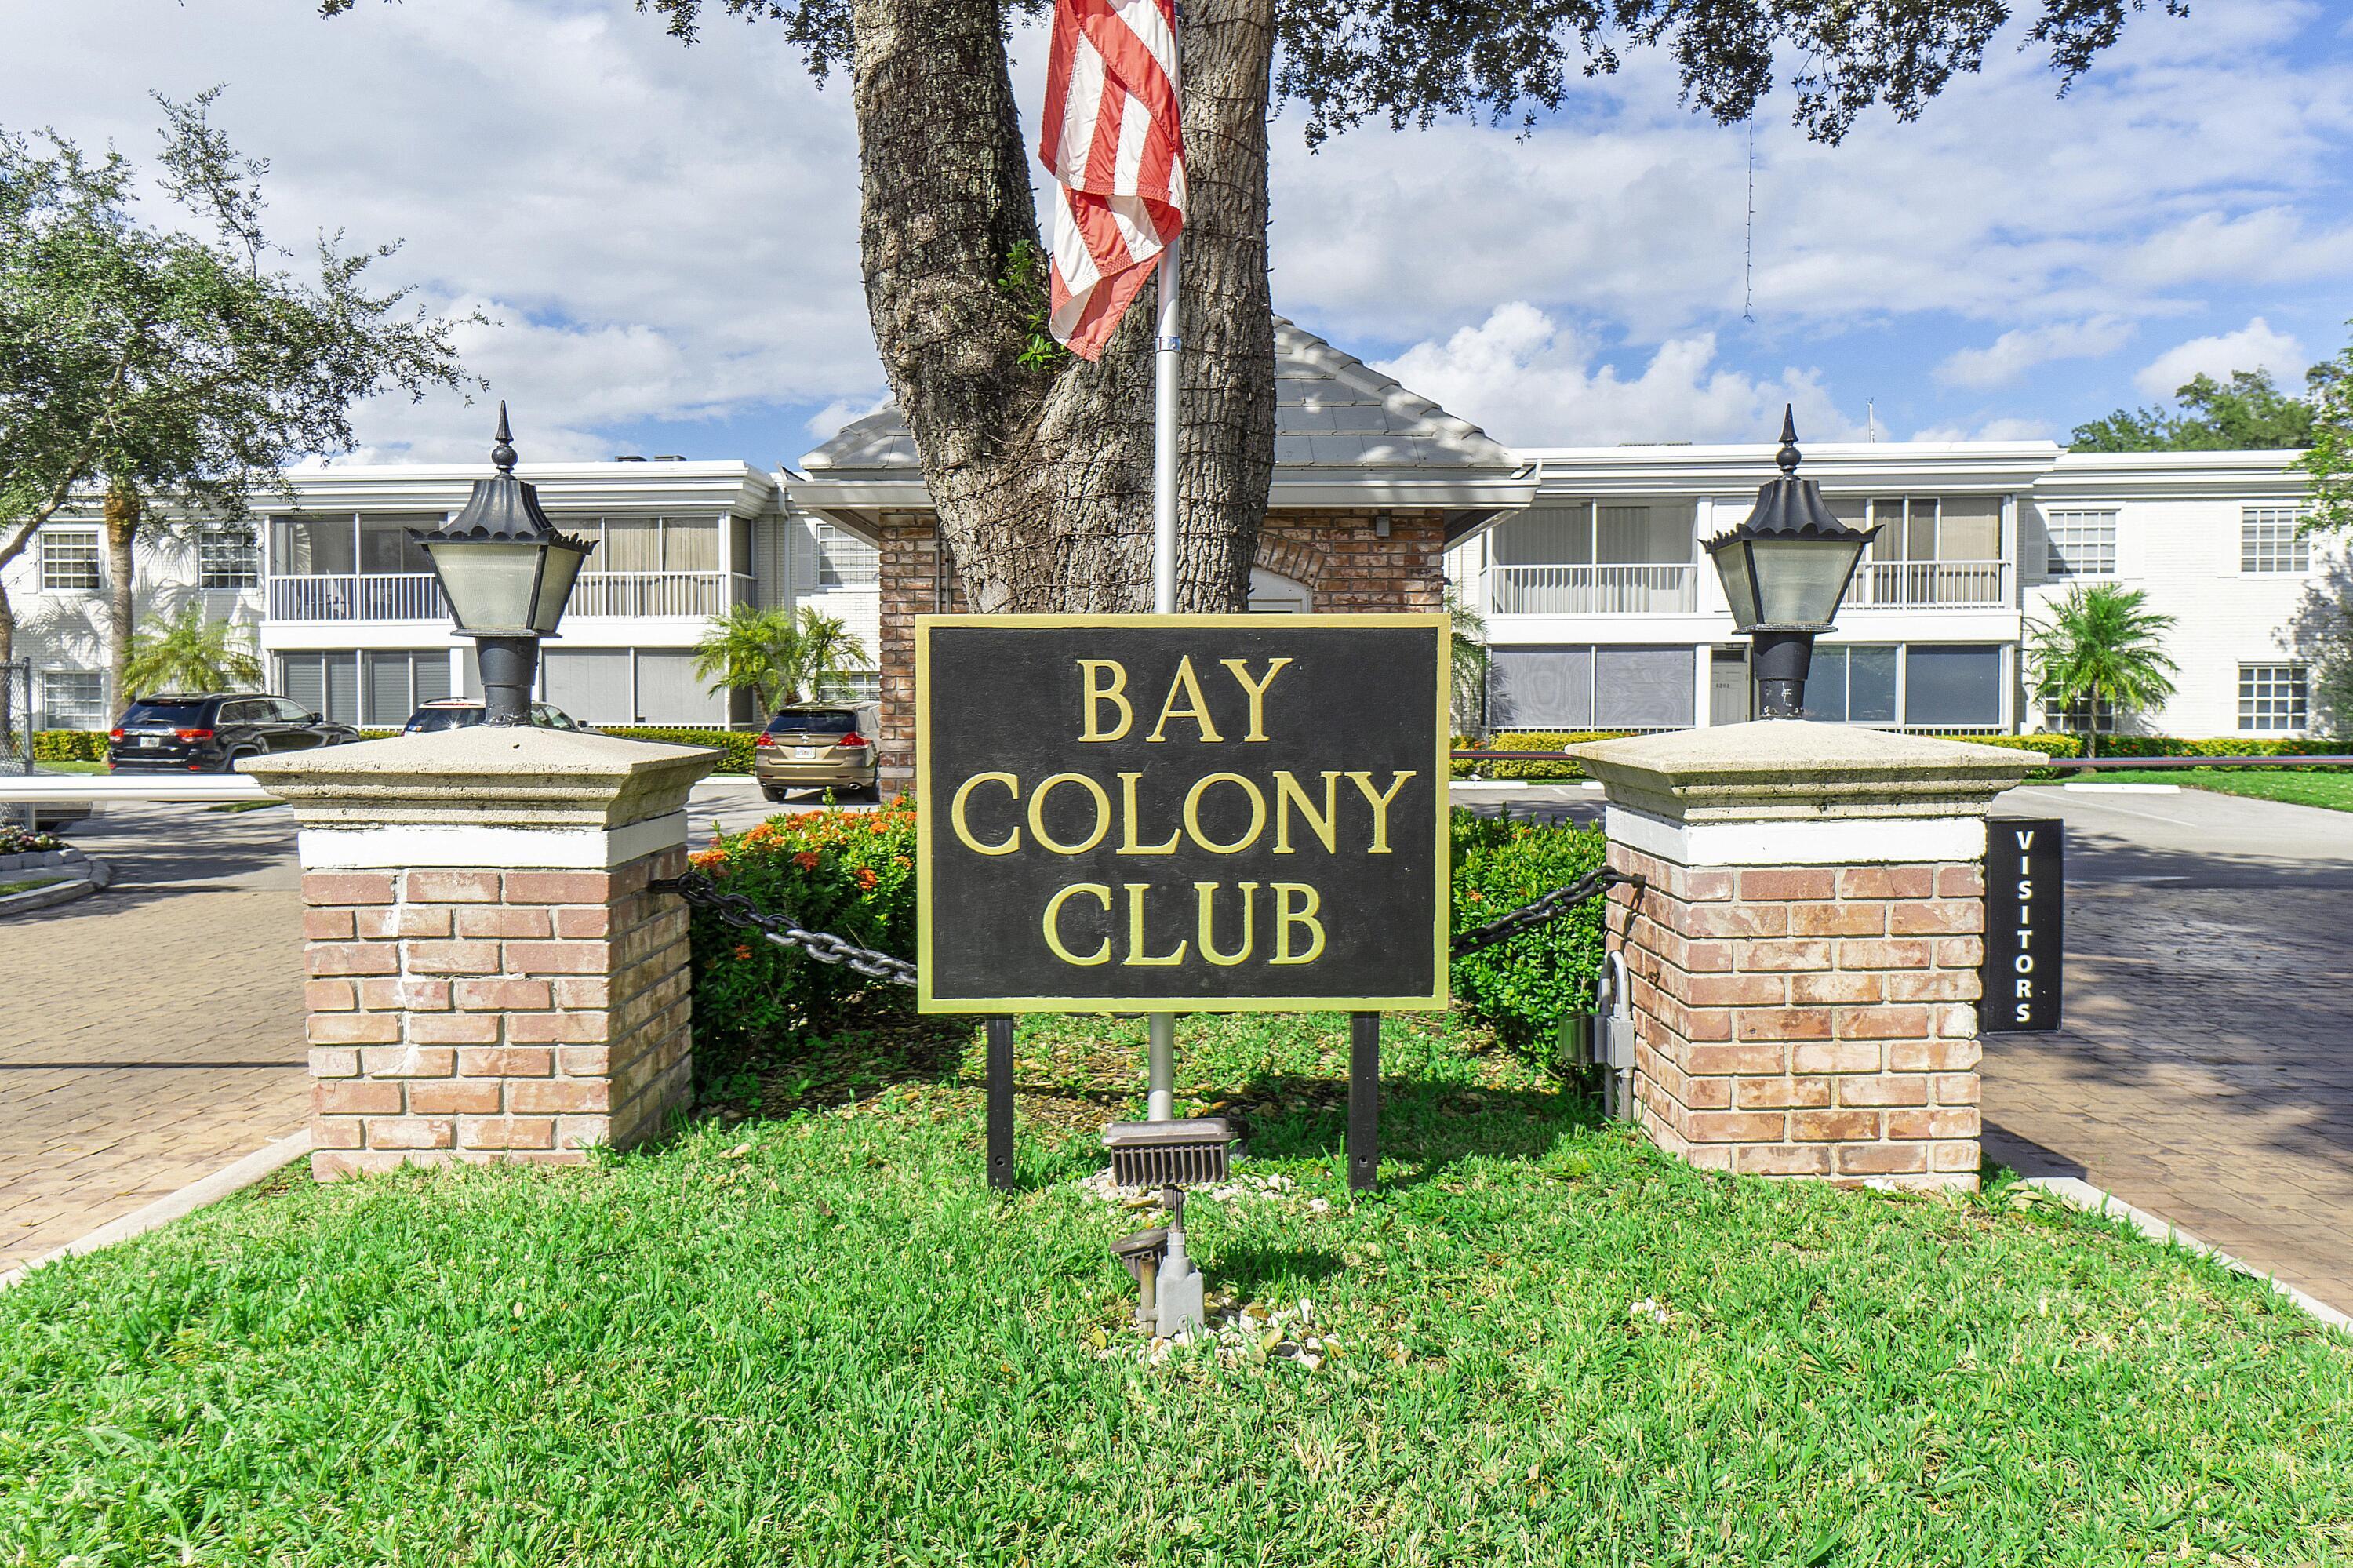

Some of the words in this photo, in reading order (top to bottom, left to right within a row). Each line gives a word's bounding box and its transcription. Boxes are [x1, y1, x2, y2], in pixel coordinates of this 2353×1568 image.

[1076, 654, 1294, 743] BAY
[951, 770, 1417, 856] COLONY
[1042, 882, 1326, 966] CLUB
[2015, 831, 2035, 1023] VISITORS
